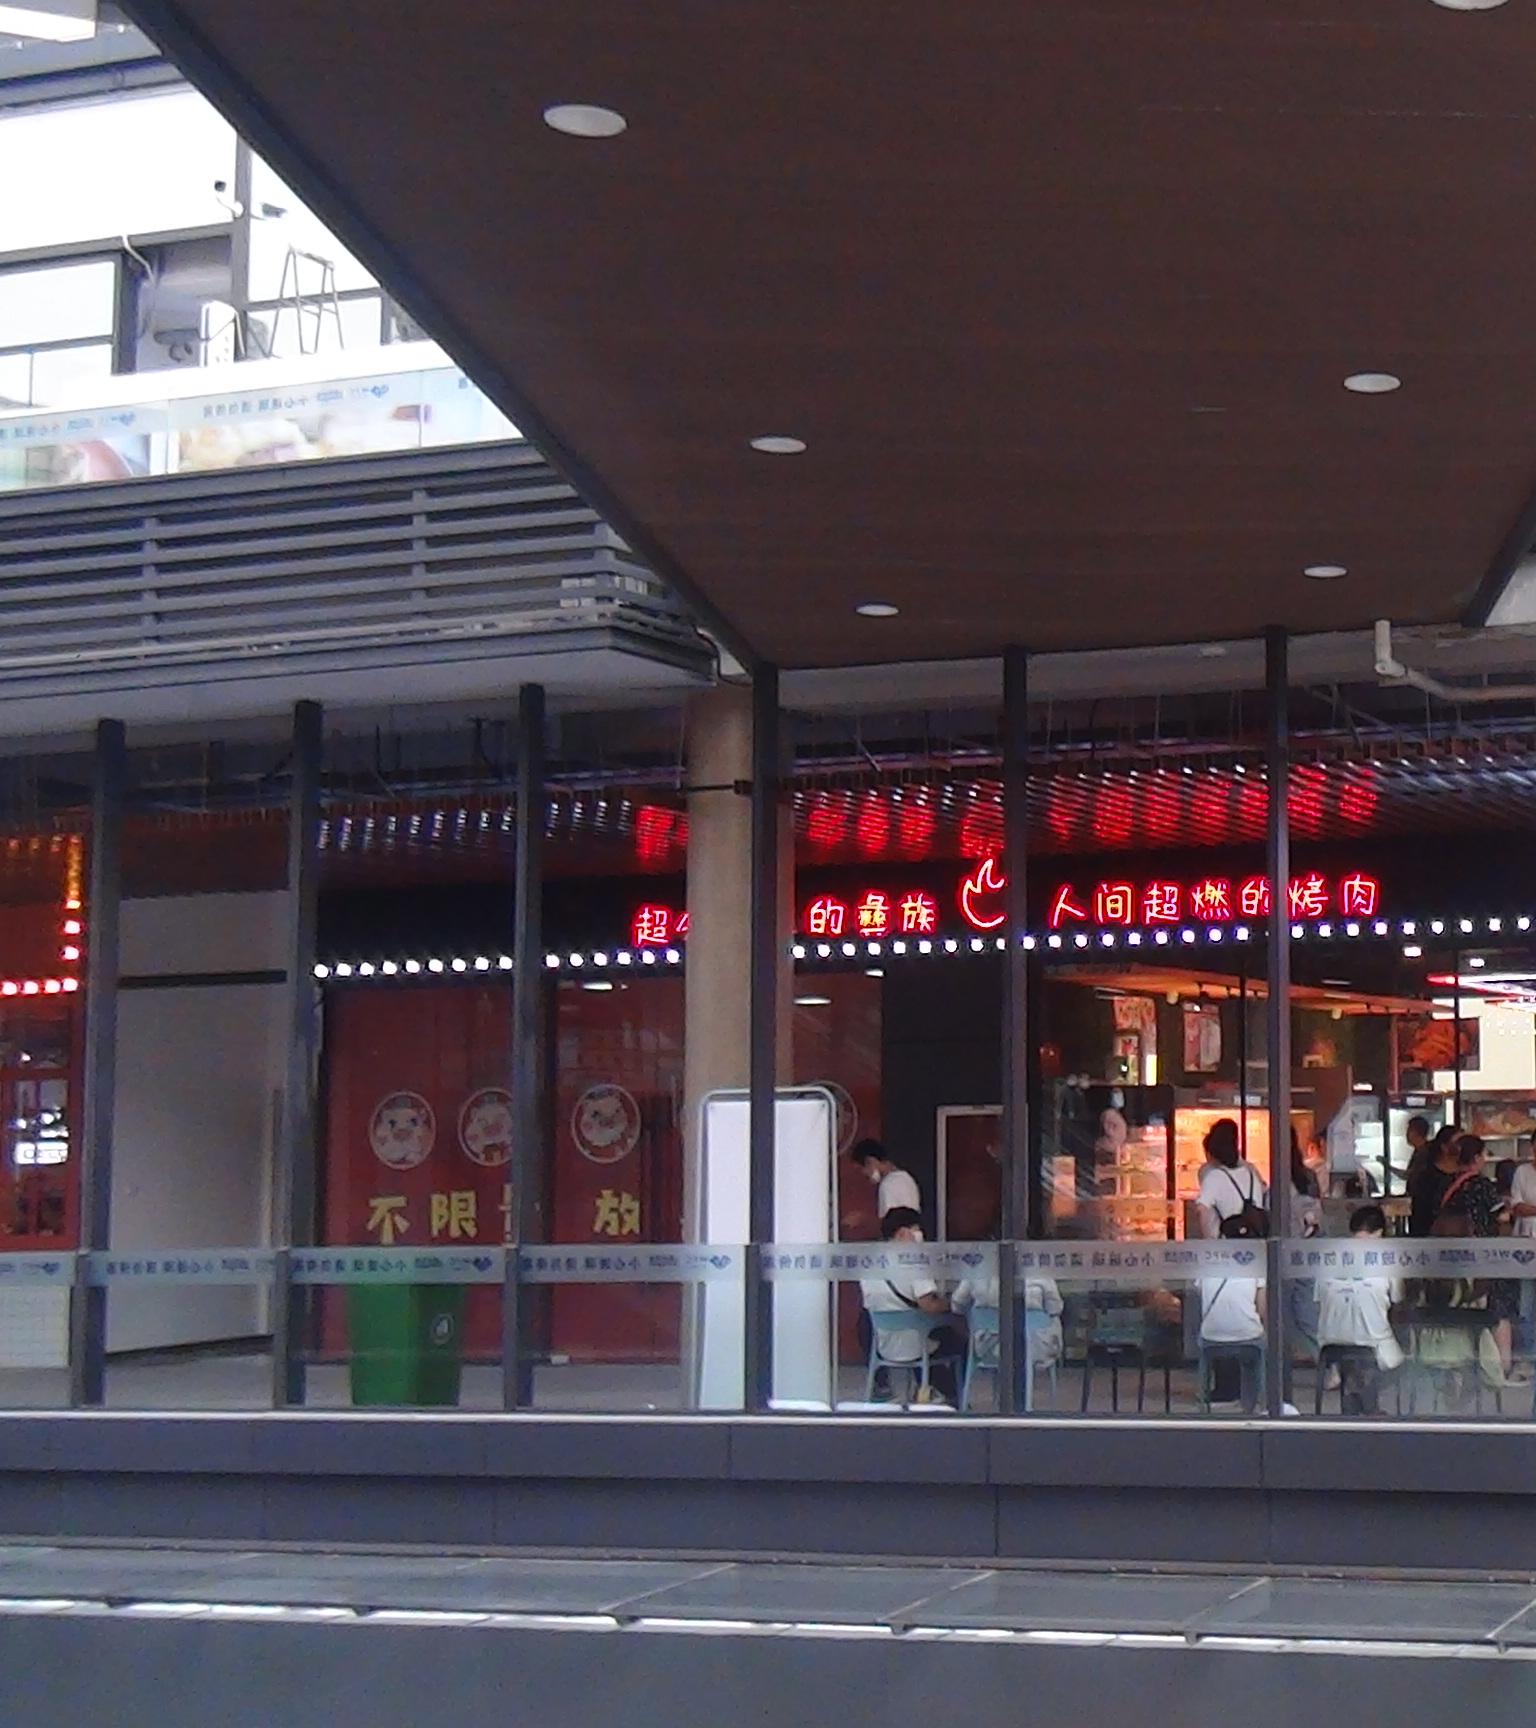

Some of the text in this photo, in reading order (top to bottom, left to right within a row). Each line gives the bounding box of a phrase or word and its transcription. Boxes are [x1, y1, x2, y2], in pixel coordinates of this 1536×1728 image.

[1051, 873, 1377, 928] 人间超燃的烤肉
